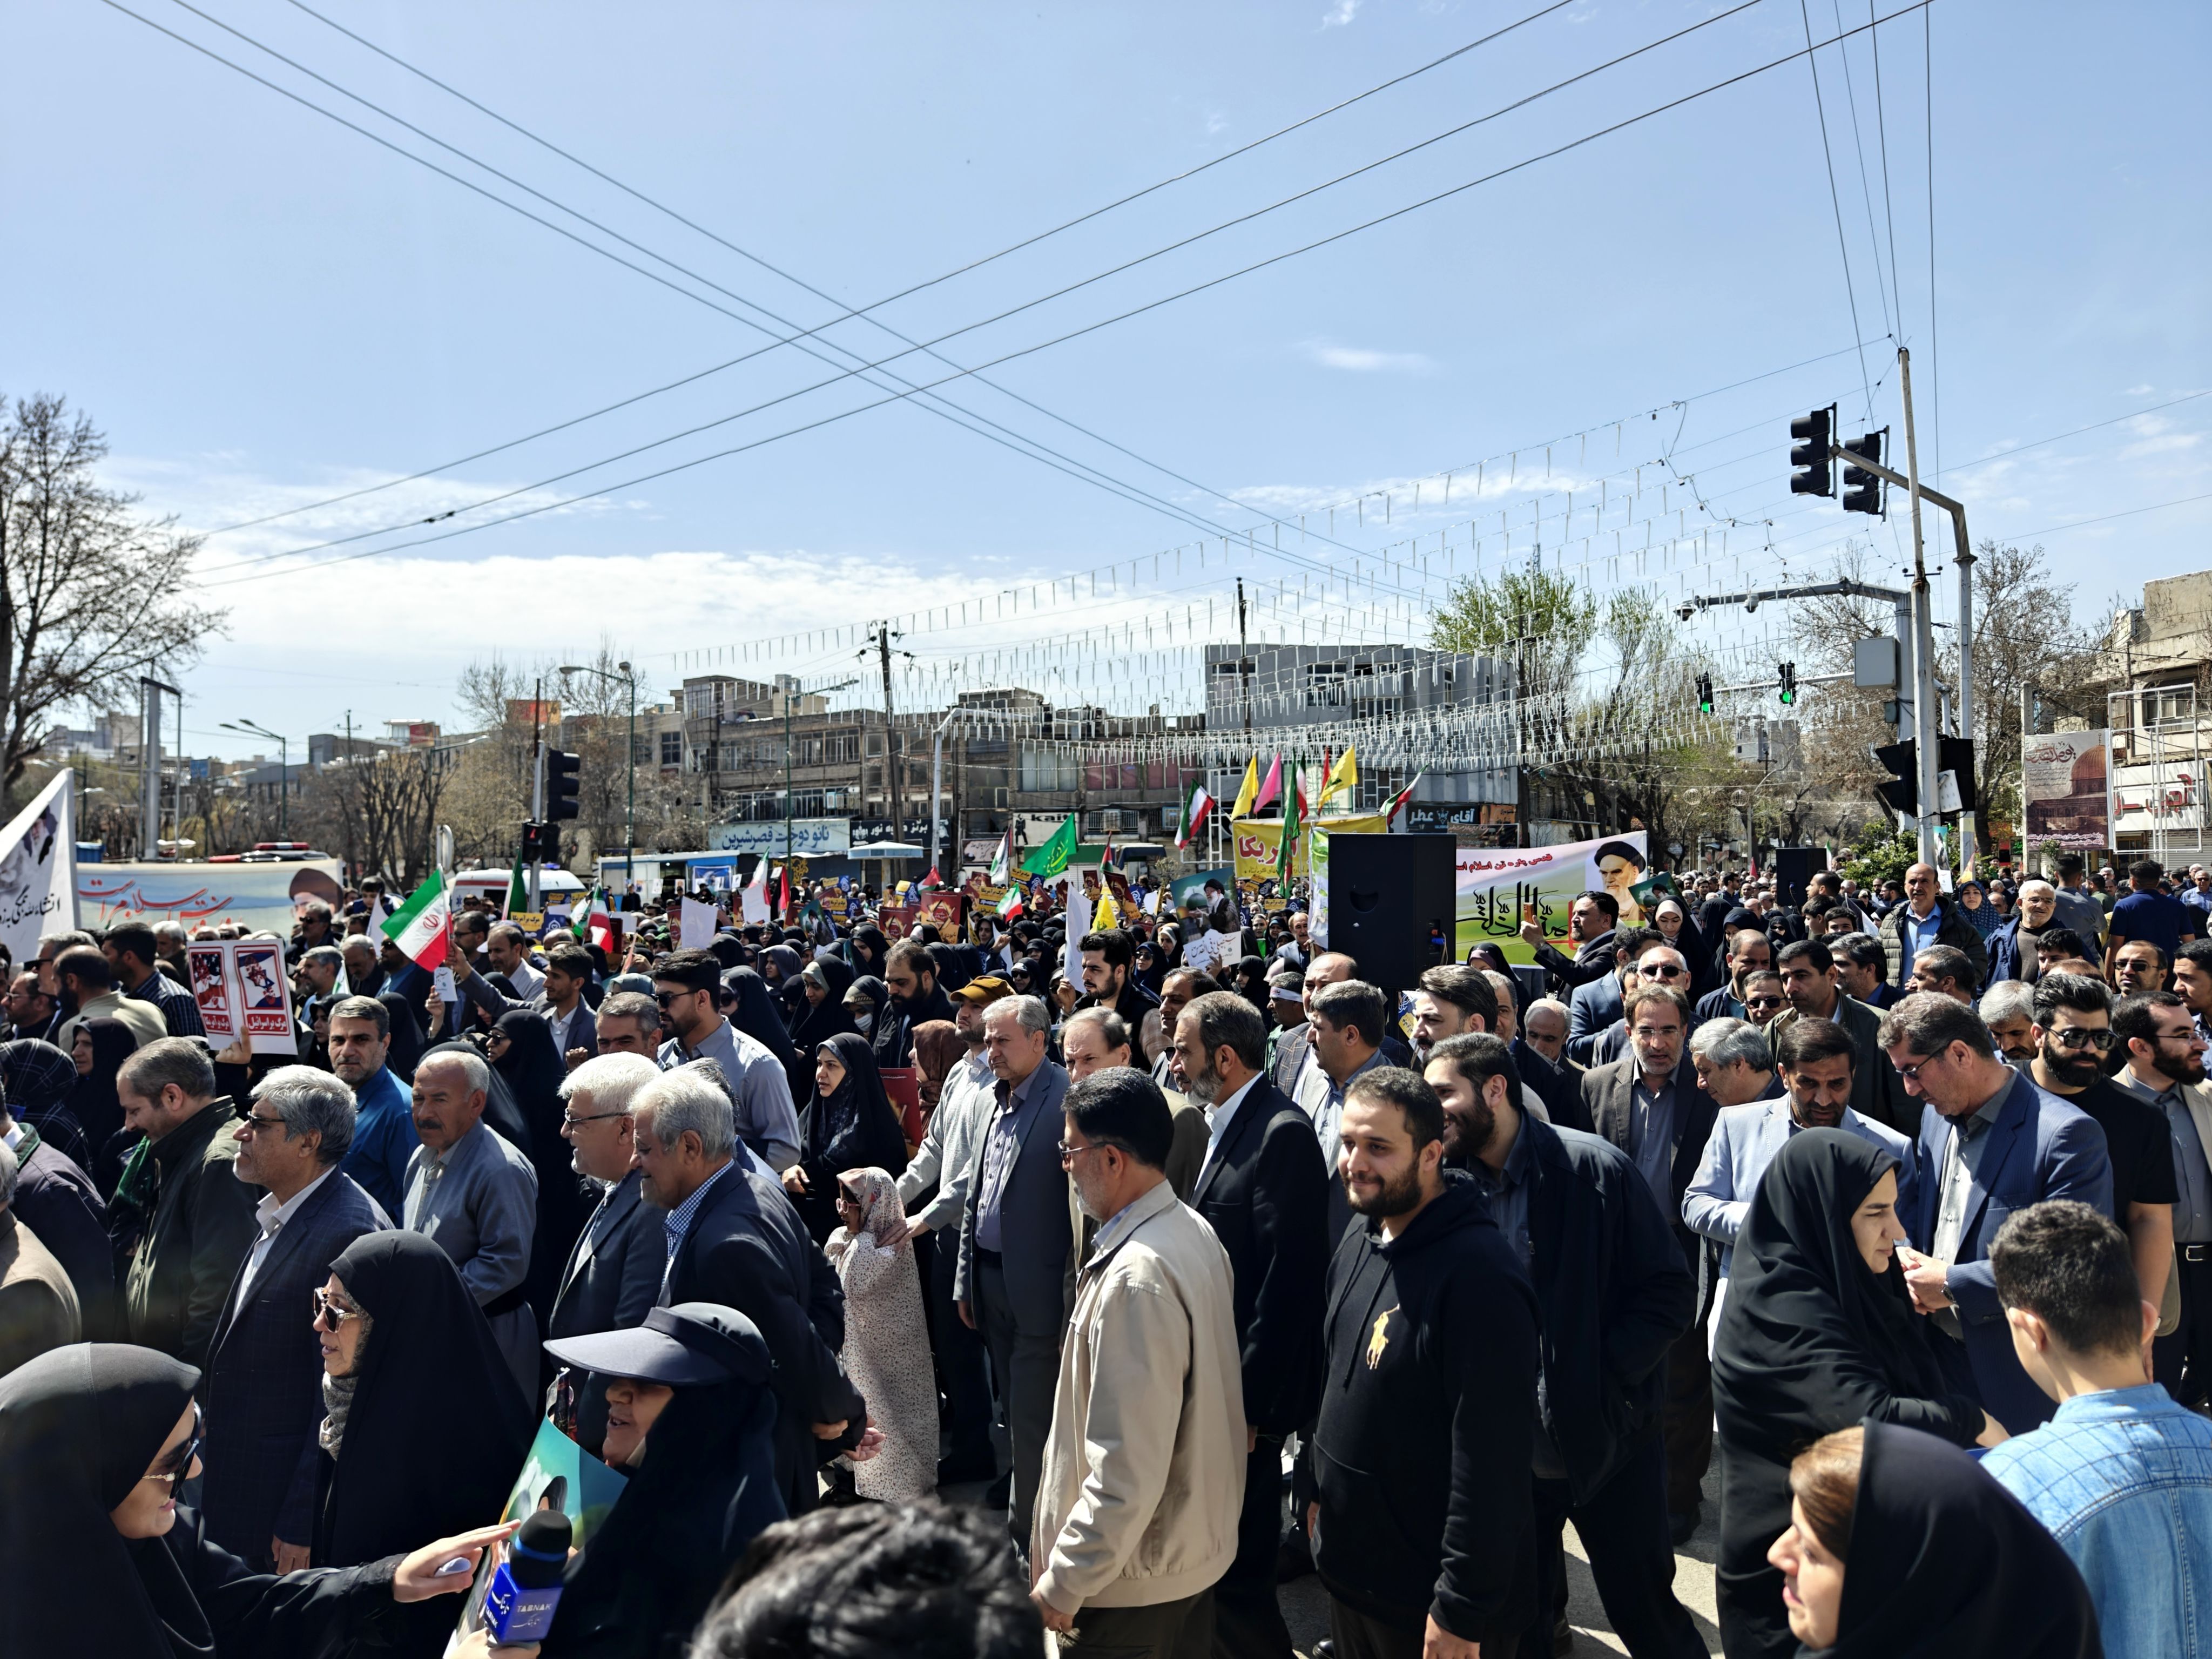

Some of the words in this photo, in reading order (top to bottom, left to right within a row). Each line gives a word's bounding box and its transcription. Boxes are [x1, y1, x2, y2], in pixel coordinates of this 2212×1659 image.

[1409, 809, 1434, 825] عطر
[1494, 860, 1506, 871] تن
[1507, 858, 1528, 868] پاره
[1529, 853, 1553, 866] قدس
[1456, 861, 1468, 871] اس
[1469, 860, 1492, 873] اسلام
[249, 1016, 269, 1030] اسرائیل
[269, 1019, 275, 1030] بر
[275, 1017, 287, 1030] مرگ
[517, 1603, 552, 1613] TABNAK
